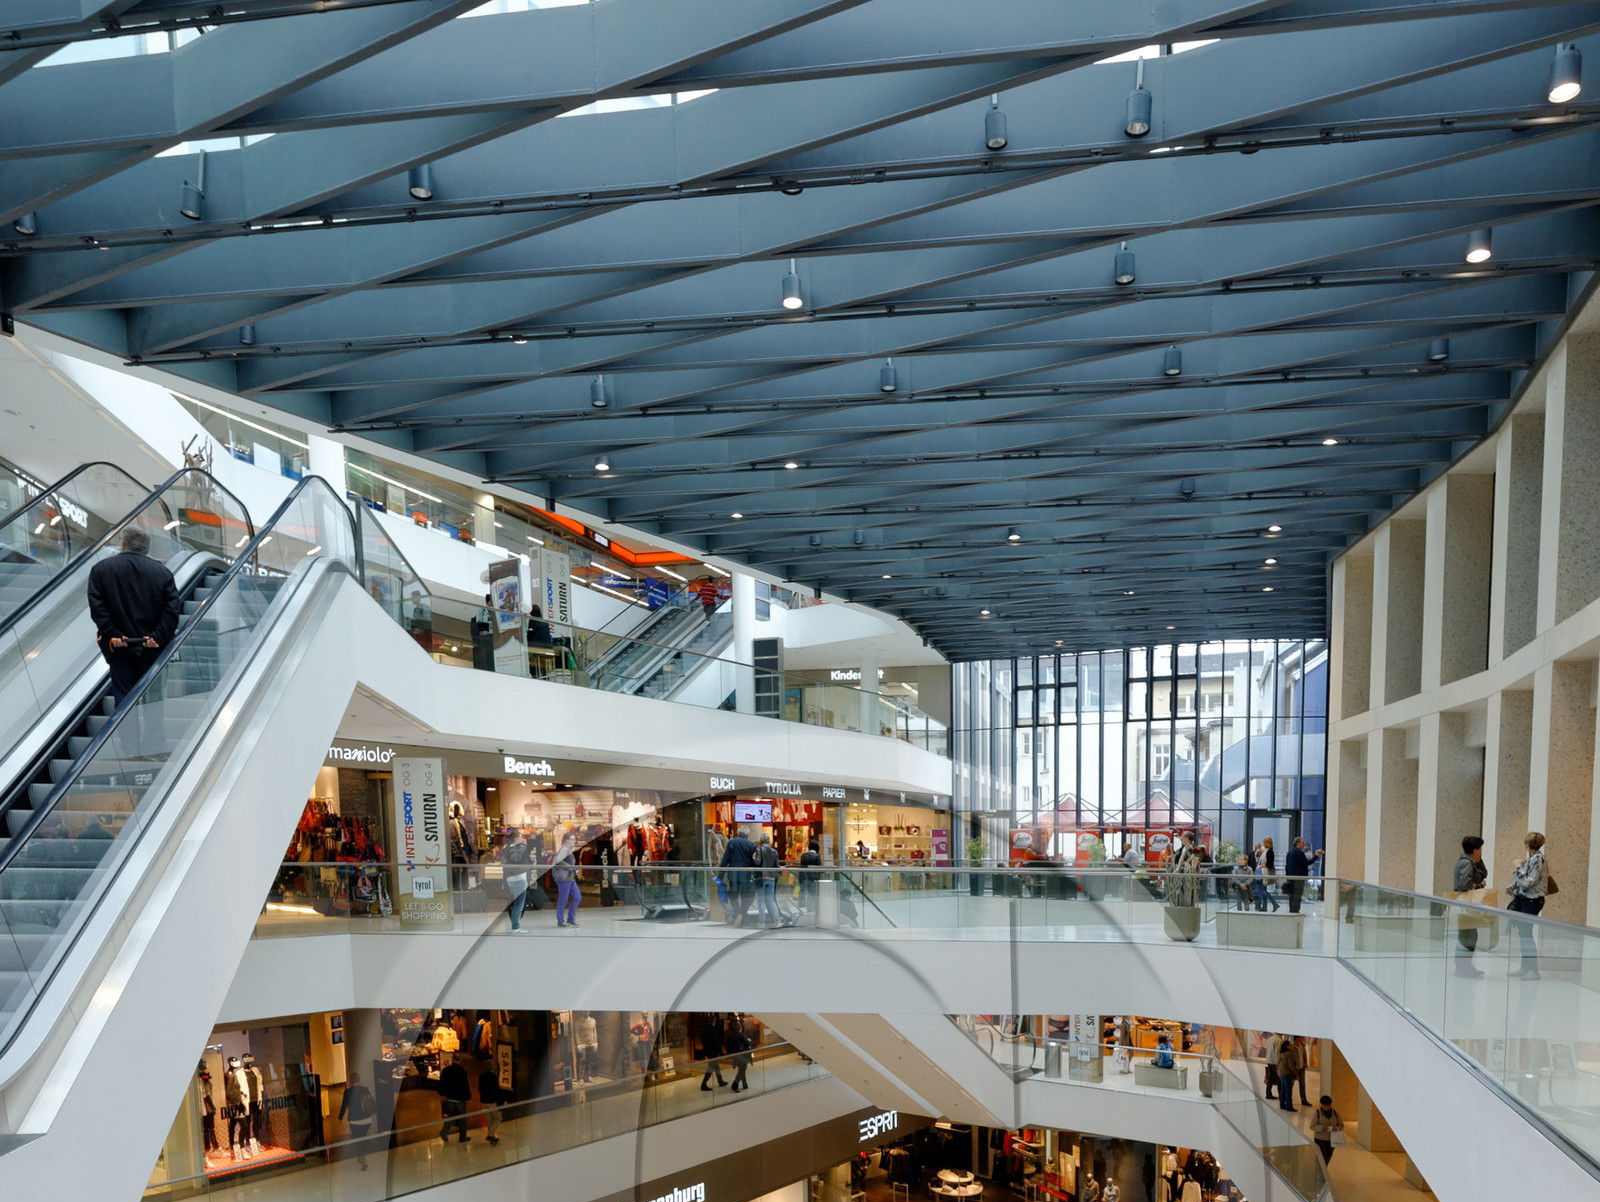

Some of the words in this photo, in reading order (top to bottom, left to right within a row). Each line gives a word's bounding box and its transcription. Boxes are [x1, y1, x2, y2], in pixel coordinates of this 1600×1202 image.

[546, 577, 555, 634] INERSPORT
[559, 582, 568, 622] SATURN
[504, 757, 555, 777] Bench.
[403, 771, 411, 786] OG
[425, 771, 433, 787] OG
[710, 777, 735, 790] BUCH
[765, 782, 801, 795] TYROLIA
[823, 787, 846, 798] PAPIER
[403, 792, 415, 858] INTERSPORT
[423, 793, 438, 842] SATURN
[415, 880, 432, 891] tyrol
[404, 902, 426, 911] LET'S
[429, 902, 444, 911] GO
[401, 911, 447, 920] SHOPPING
[501, 1052, 510, 1084] SALE
[858, 1109, 898, 1143] ESPRIT
